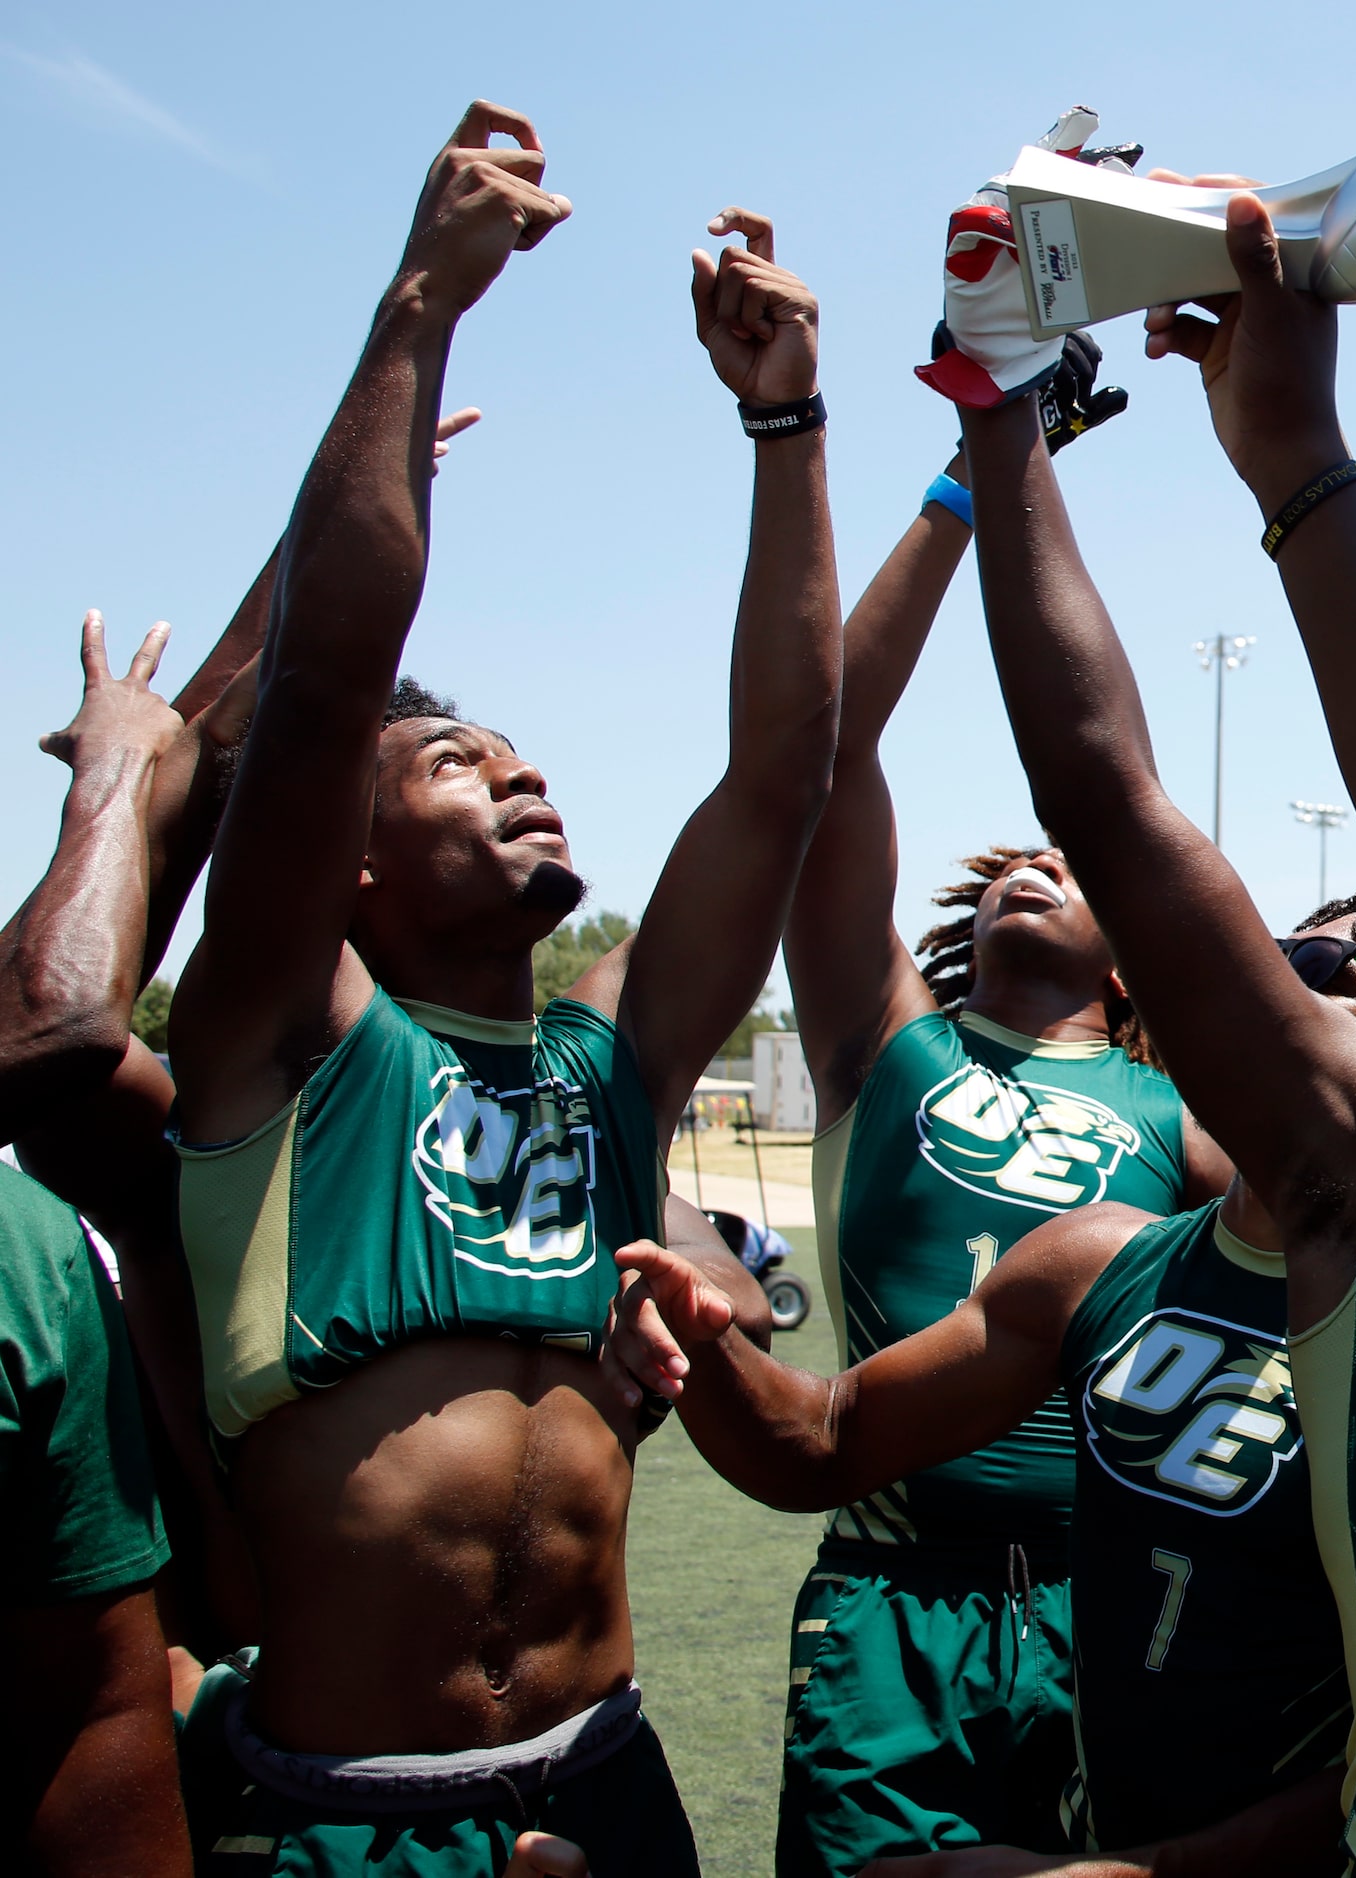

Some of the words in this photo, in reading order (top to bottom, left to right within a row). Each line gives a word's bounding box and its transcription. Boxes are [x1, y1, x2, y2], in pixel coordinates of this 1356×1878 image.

[1030, 210, 1046, 261] PRESENTED
[1040, 263, 1048, 274] BY
[768, 414, 800, 429] TEXAS
[1282, 495, 1308, 524] 2021
[1304, 463, 1356, 502] DALLAS
[925, 1068, 1101, 1203] DE
[1093, 1321, 1287, 1501] DE
[1144, 1547, 1193, 1672] 7
